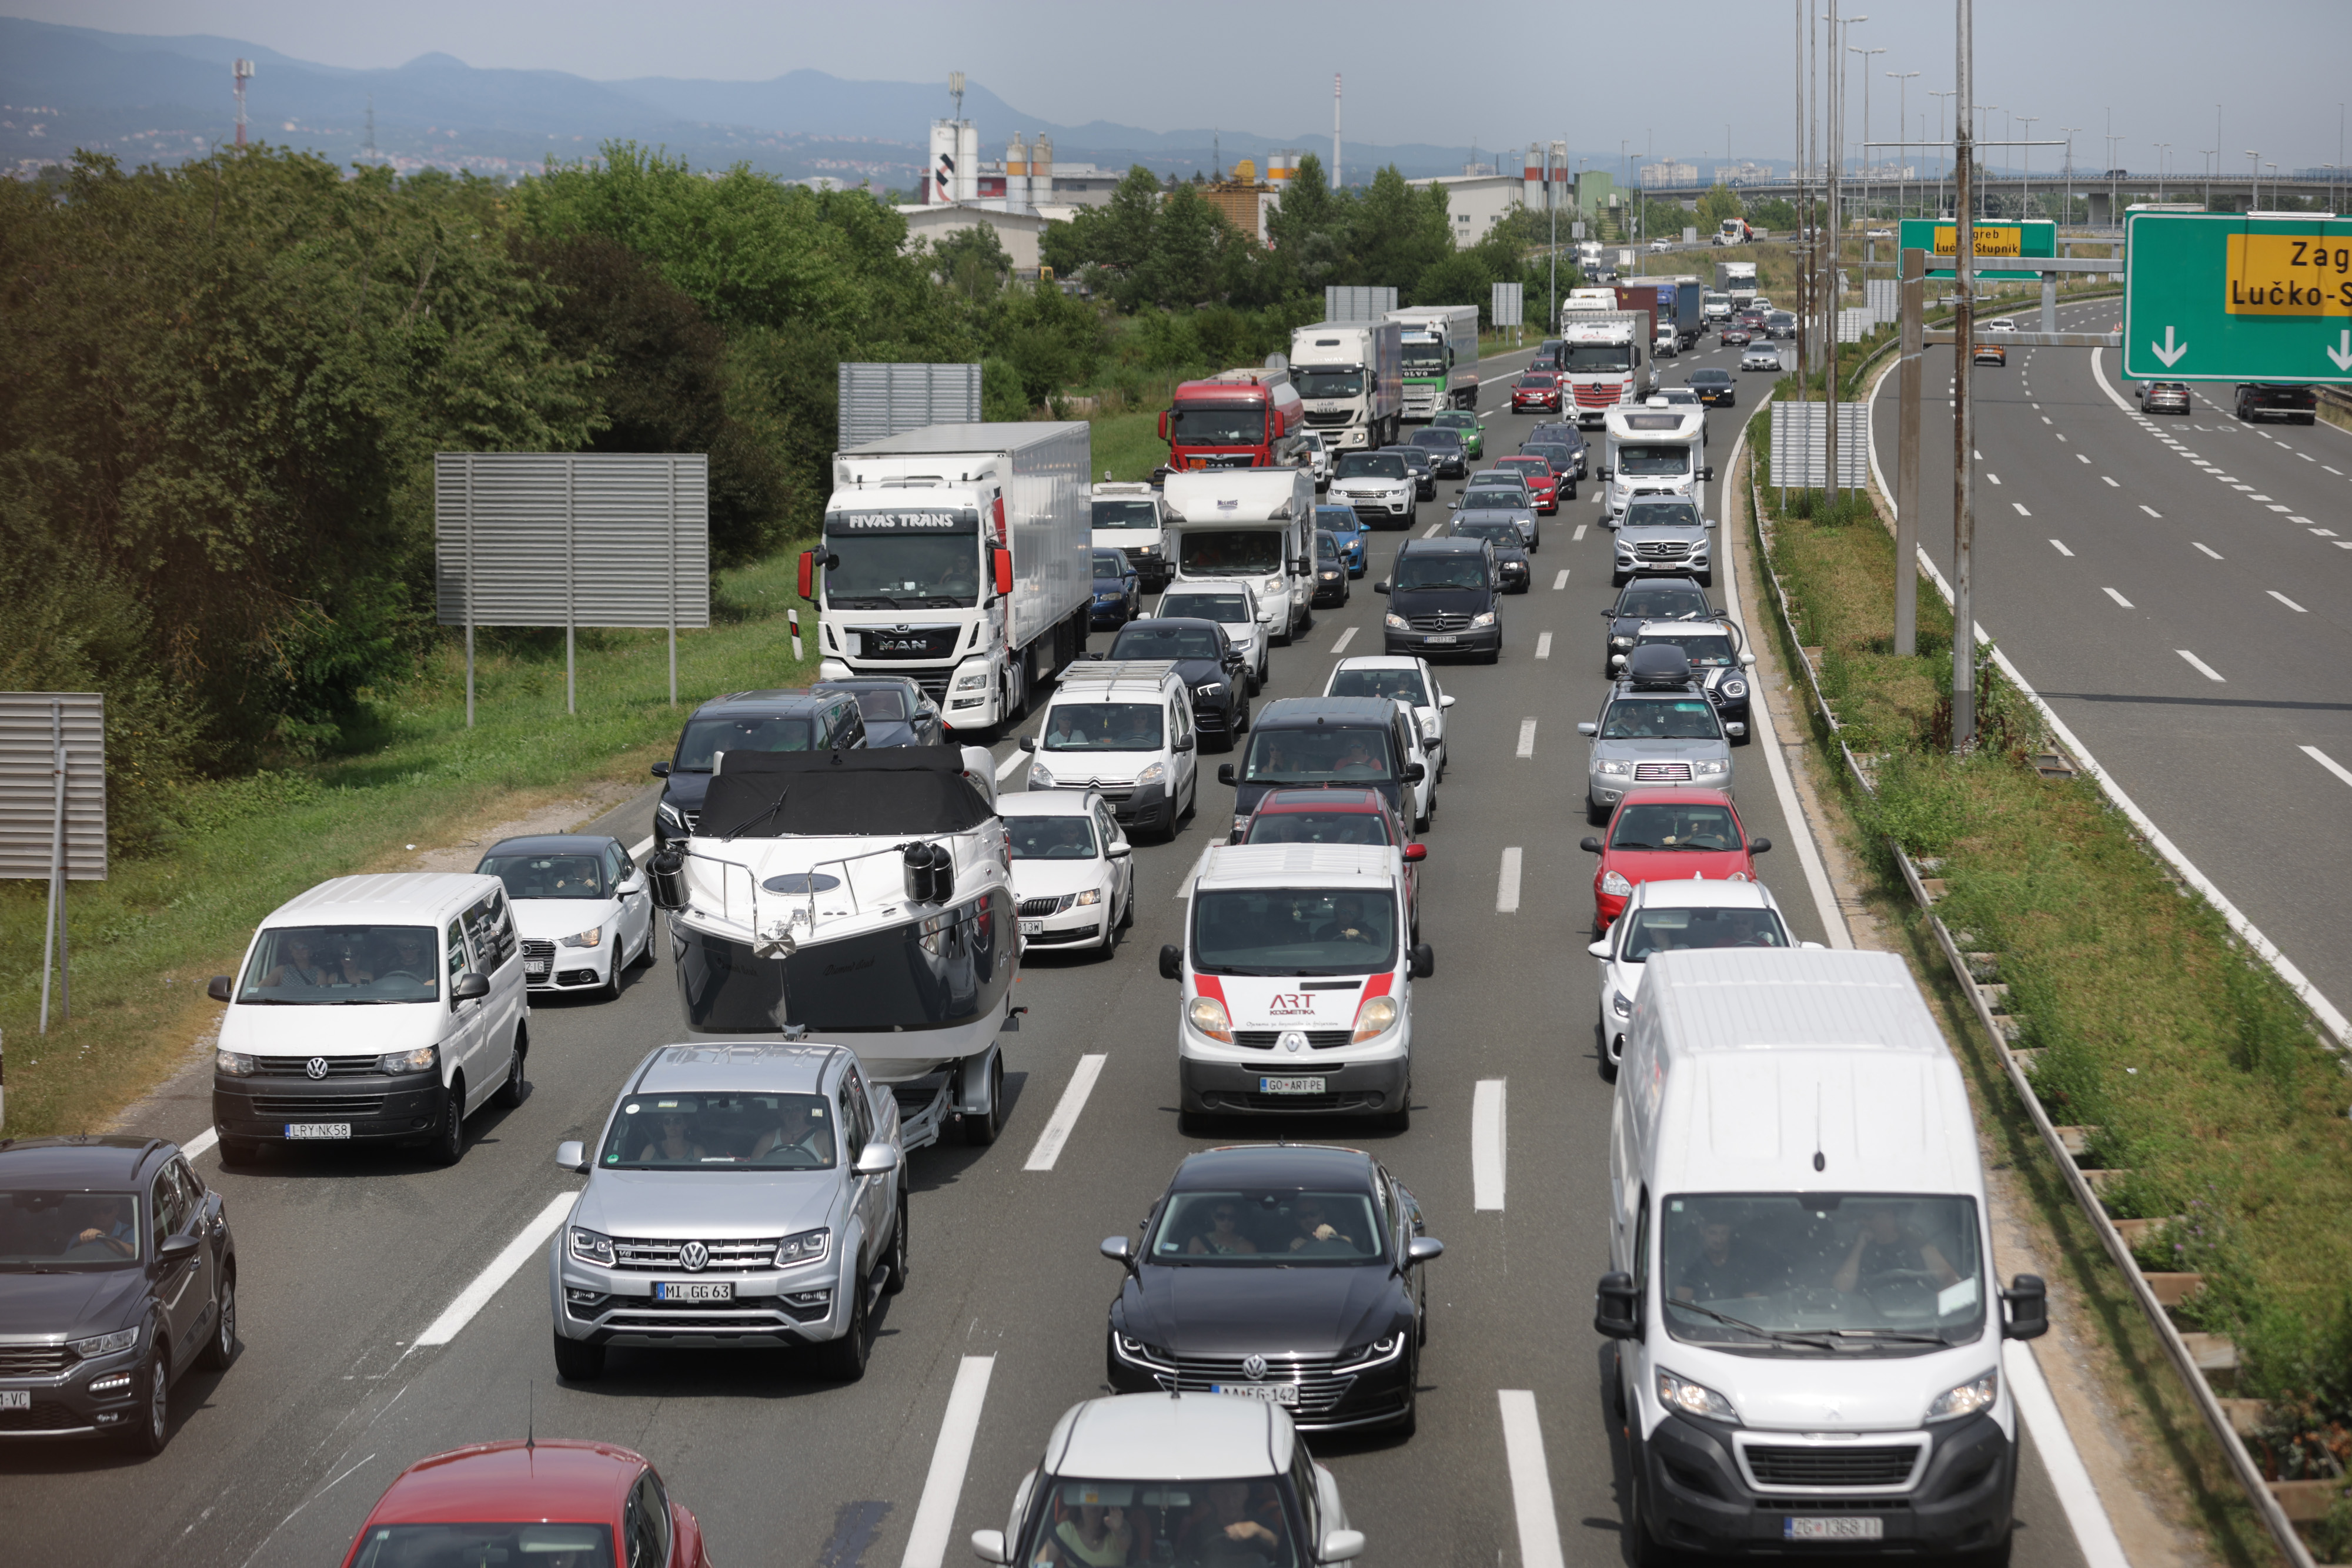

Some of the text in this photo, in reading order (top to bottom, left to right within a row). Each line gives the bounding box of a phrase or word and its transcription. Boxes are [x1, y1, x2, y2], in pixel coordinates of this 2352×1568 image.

[1973, 229, 1999, 240] greb
[1936, 243, 2018, 255] LučStupnik
[2291, 242, 2349, 274] Zag
[849, 513, 954, 528] FIVAS TRANS
[879, 640, 927, 650] MAN
[1269, 994, 1316, 1009] ART
[1269, 1080, 1282, 1090] GO
[666, 1285, 682, 1298] MI
[691, 1285, 709, 1298] GG
[712, 1285, 729, 1298] 63
